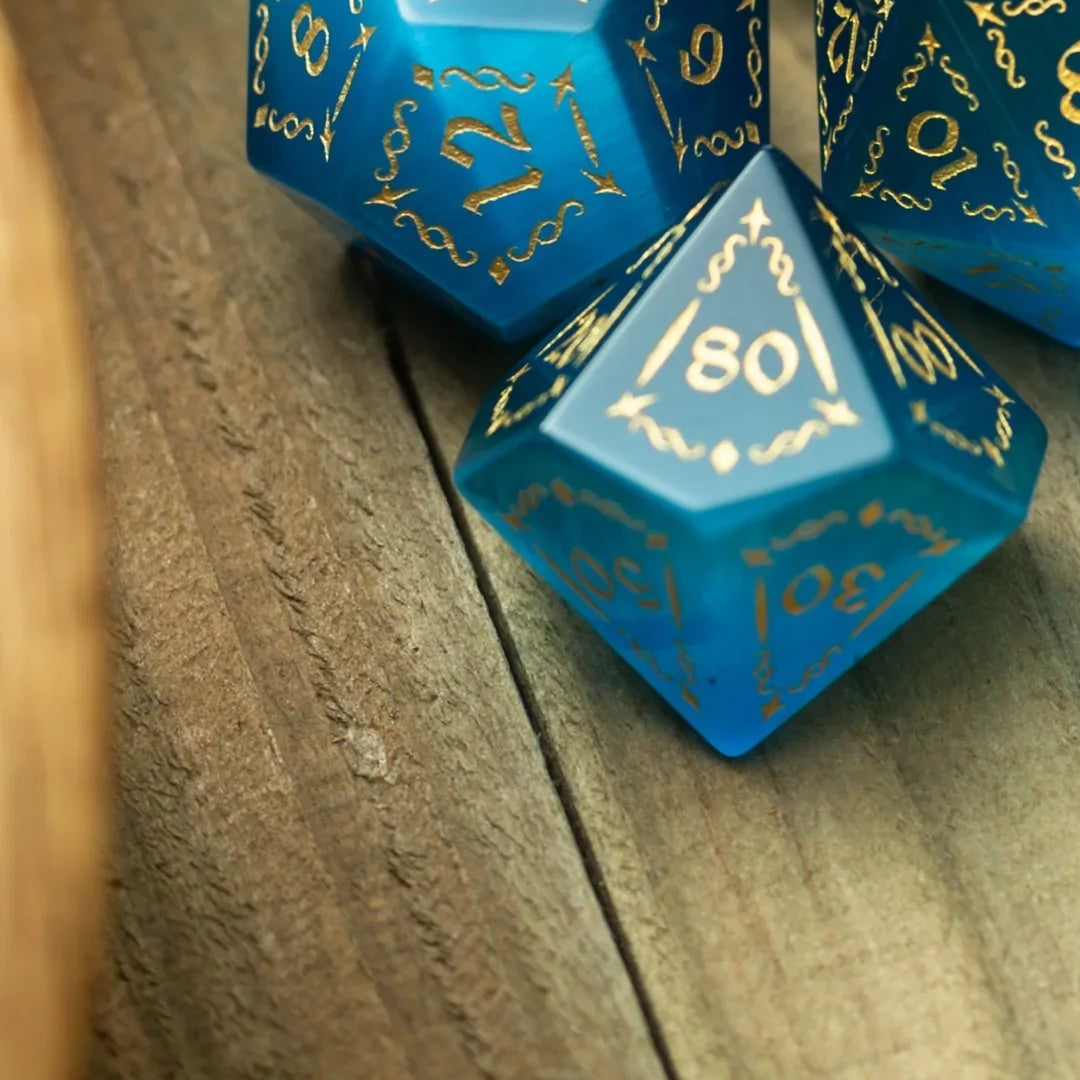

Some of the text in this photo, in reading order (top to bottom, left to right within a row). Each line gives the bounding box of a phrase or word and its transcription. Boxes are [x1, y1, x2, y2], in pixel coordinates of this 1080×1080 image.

[290, 1, 331, 78] 8
[439, 102, 545, 216] 12
[906, 109, 978, 191] 10
[684, 325, 800, 396] 80
[889, 318, 958, 385] 00
[781, 561, 886, 616] 30
